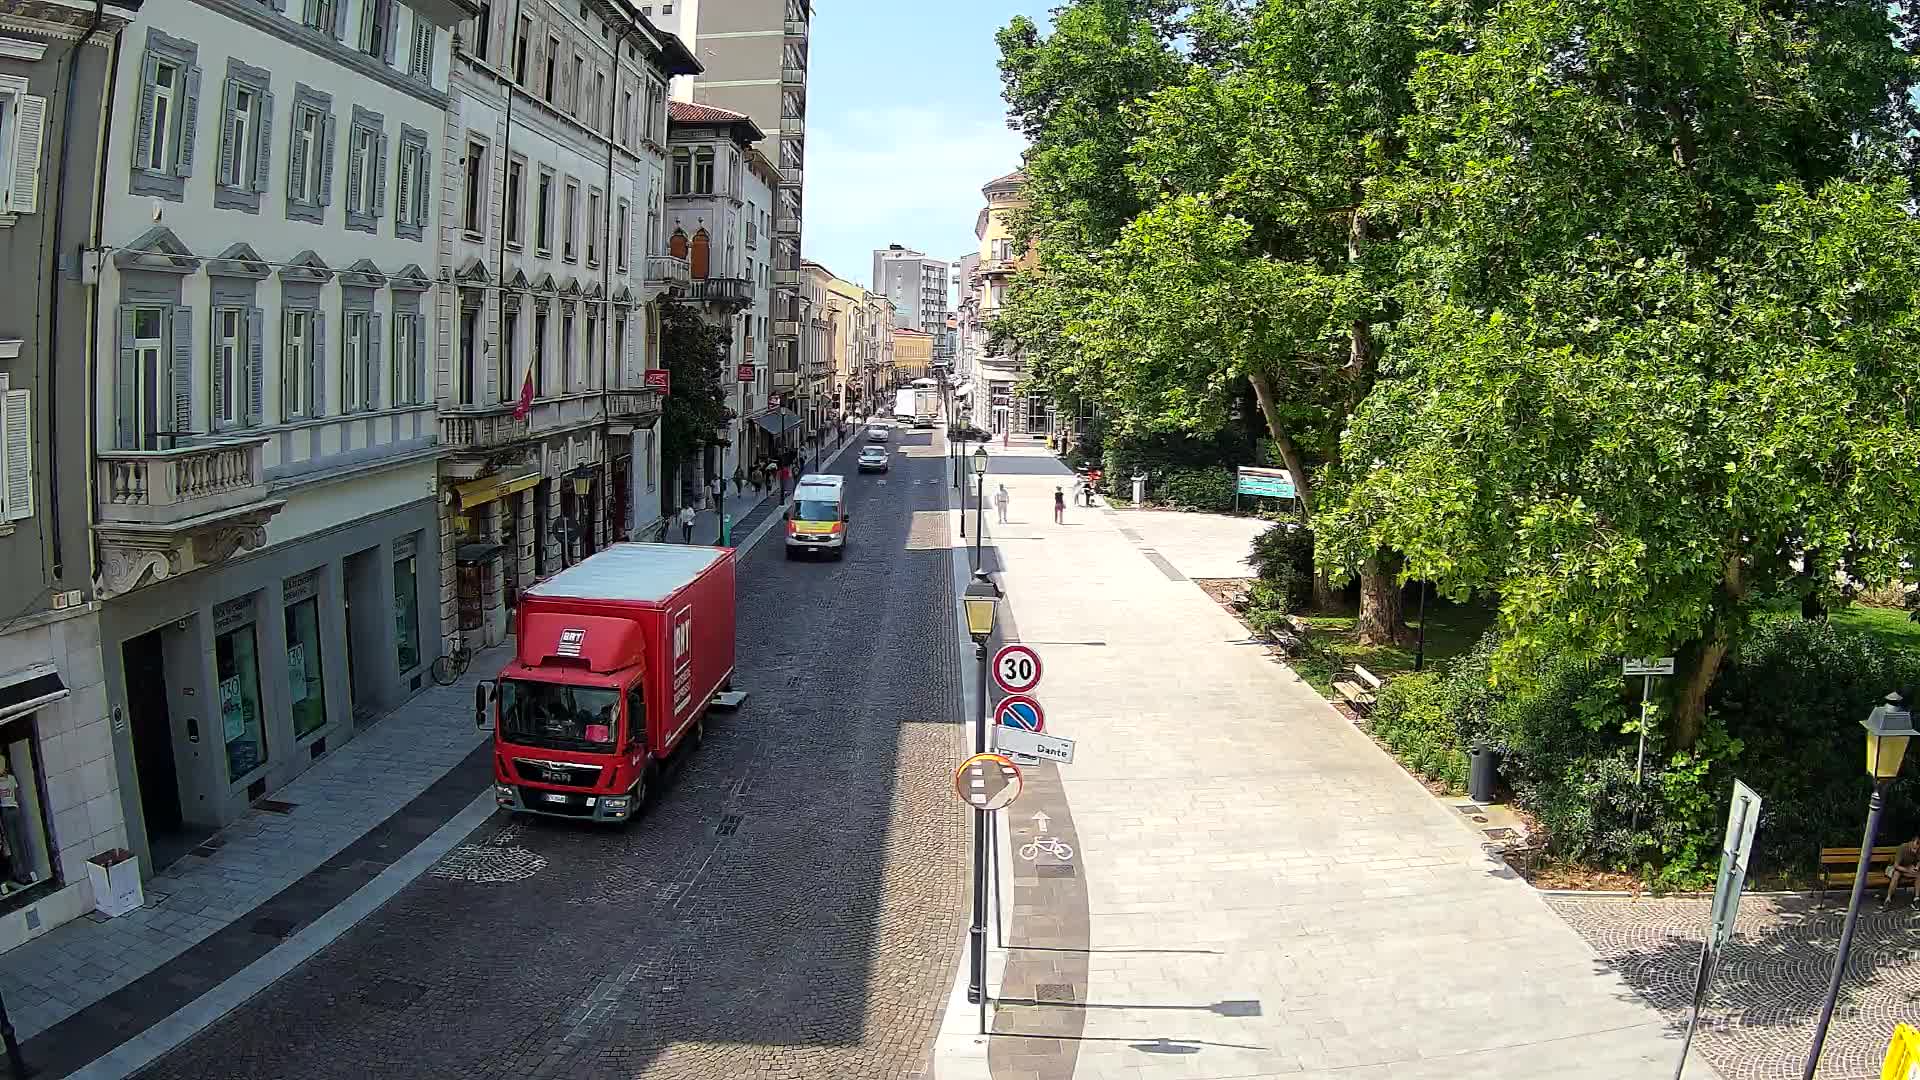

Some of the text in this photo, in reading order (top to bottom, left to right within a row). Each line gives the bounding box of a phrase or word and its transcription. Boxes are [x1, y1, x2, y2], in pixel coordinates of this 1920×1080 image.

[562, 631, 583, 641] BRT
[1004, 658, 1032, 680] 30
[1037, 744, 1068, 758] Dante
